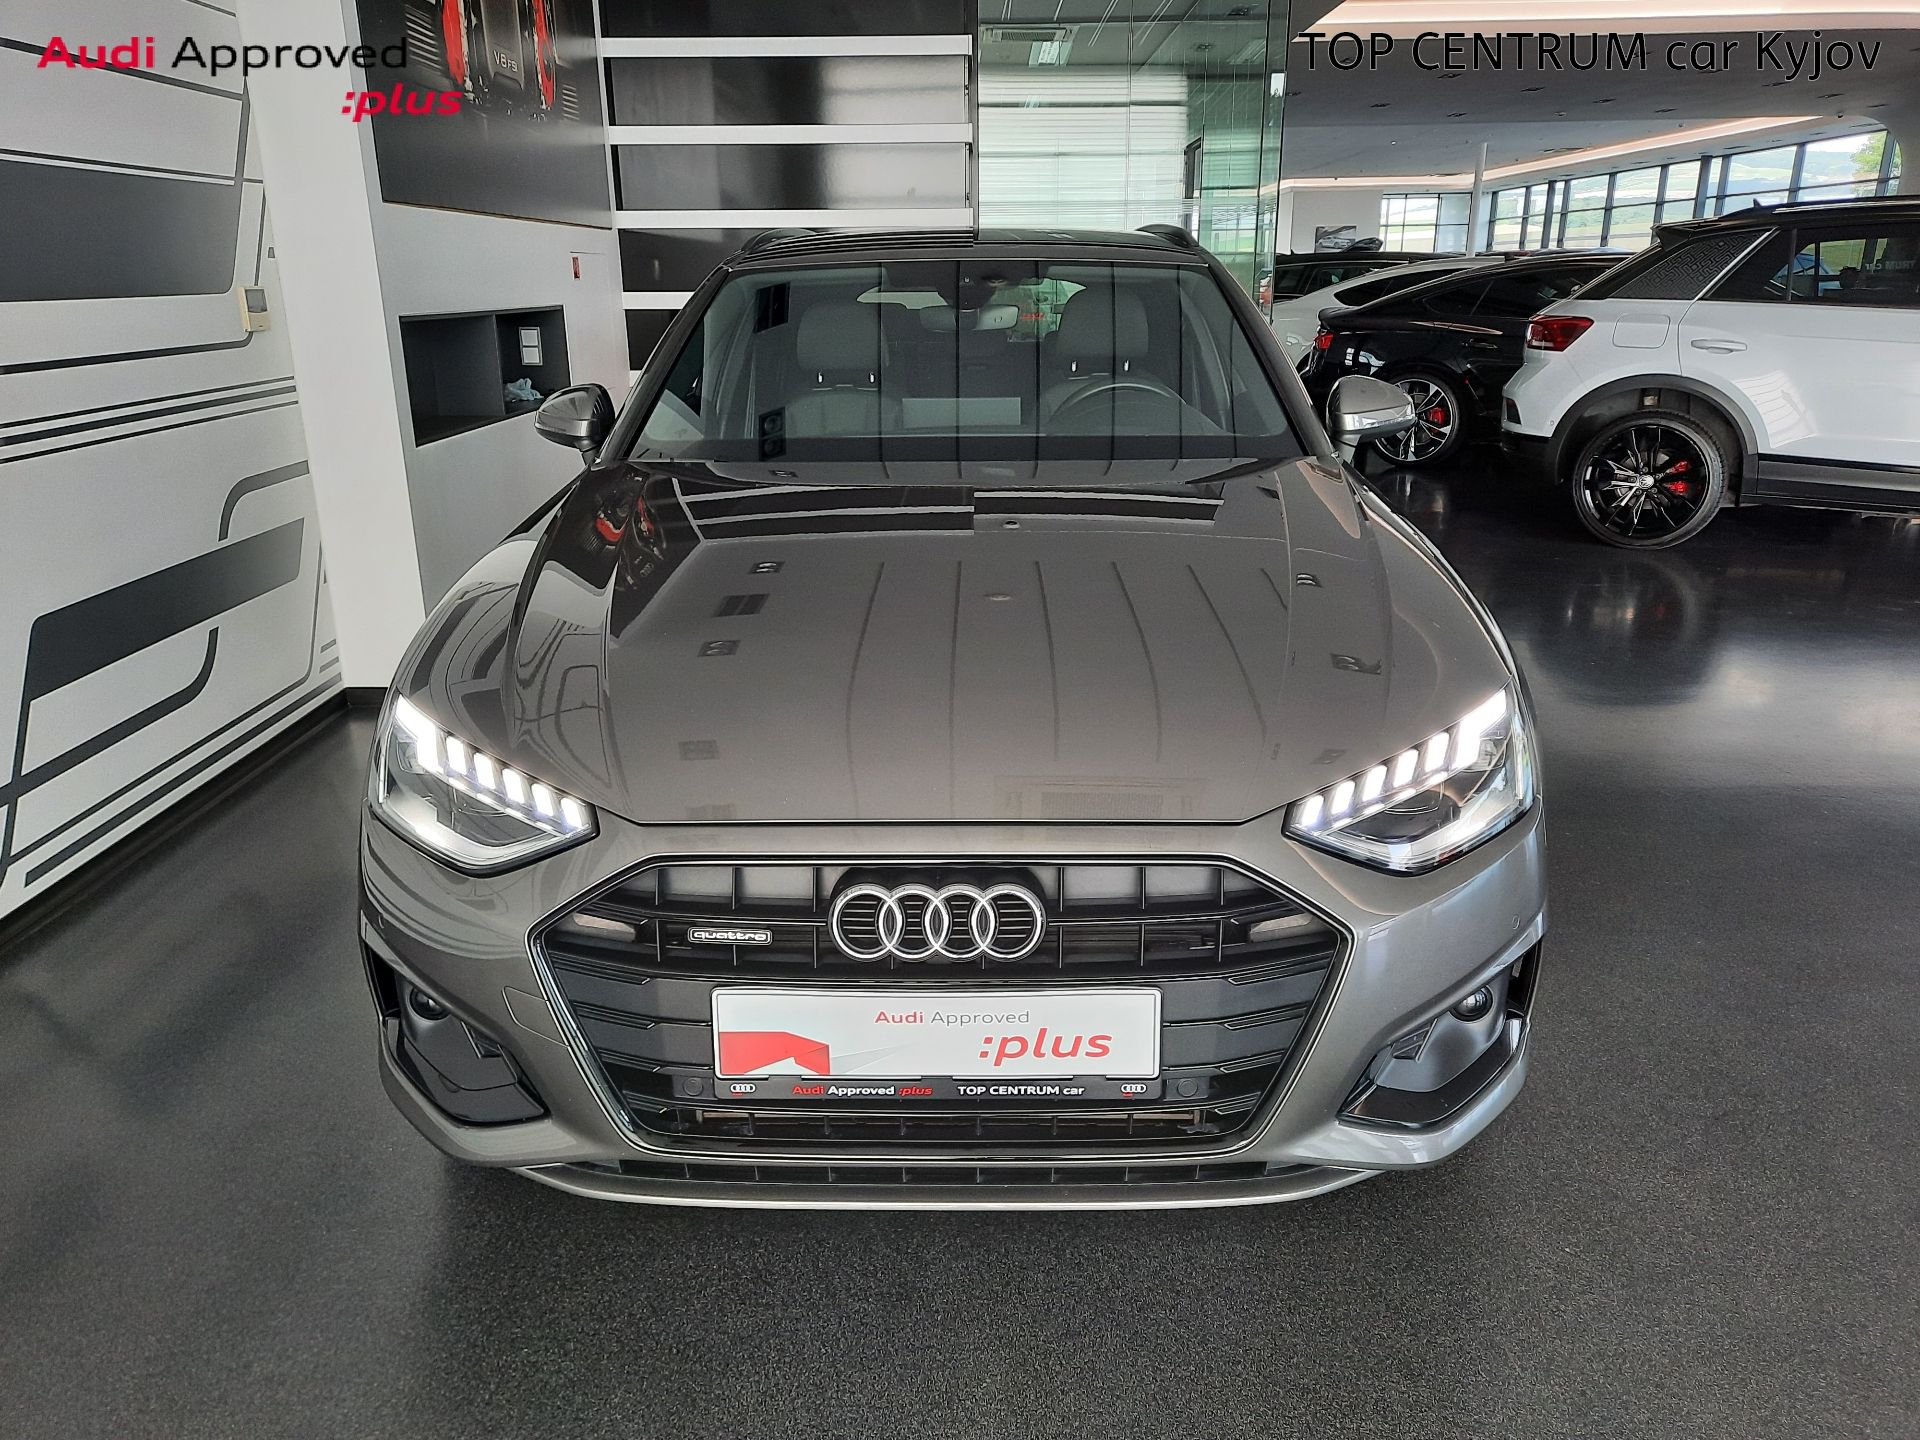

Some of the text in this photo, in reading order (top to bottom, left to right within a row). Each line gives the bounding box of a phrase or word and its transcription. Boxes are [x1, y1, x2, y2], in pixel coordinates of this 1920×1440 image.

[693, 931, 767, 941] quattro
[874, 1011, 1030, 1026] Audi Approved
[979, 1028, 1112, 1067] :plus
[792, 1086, 1085, 1096] Audi Approved :plus TOP CENTRUM car
